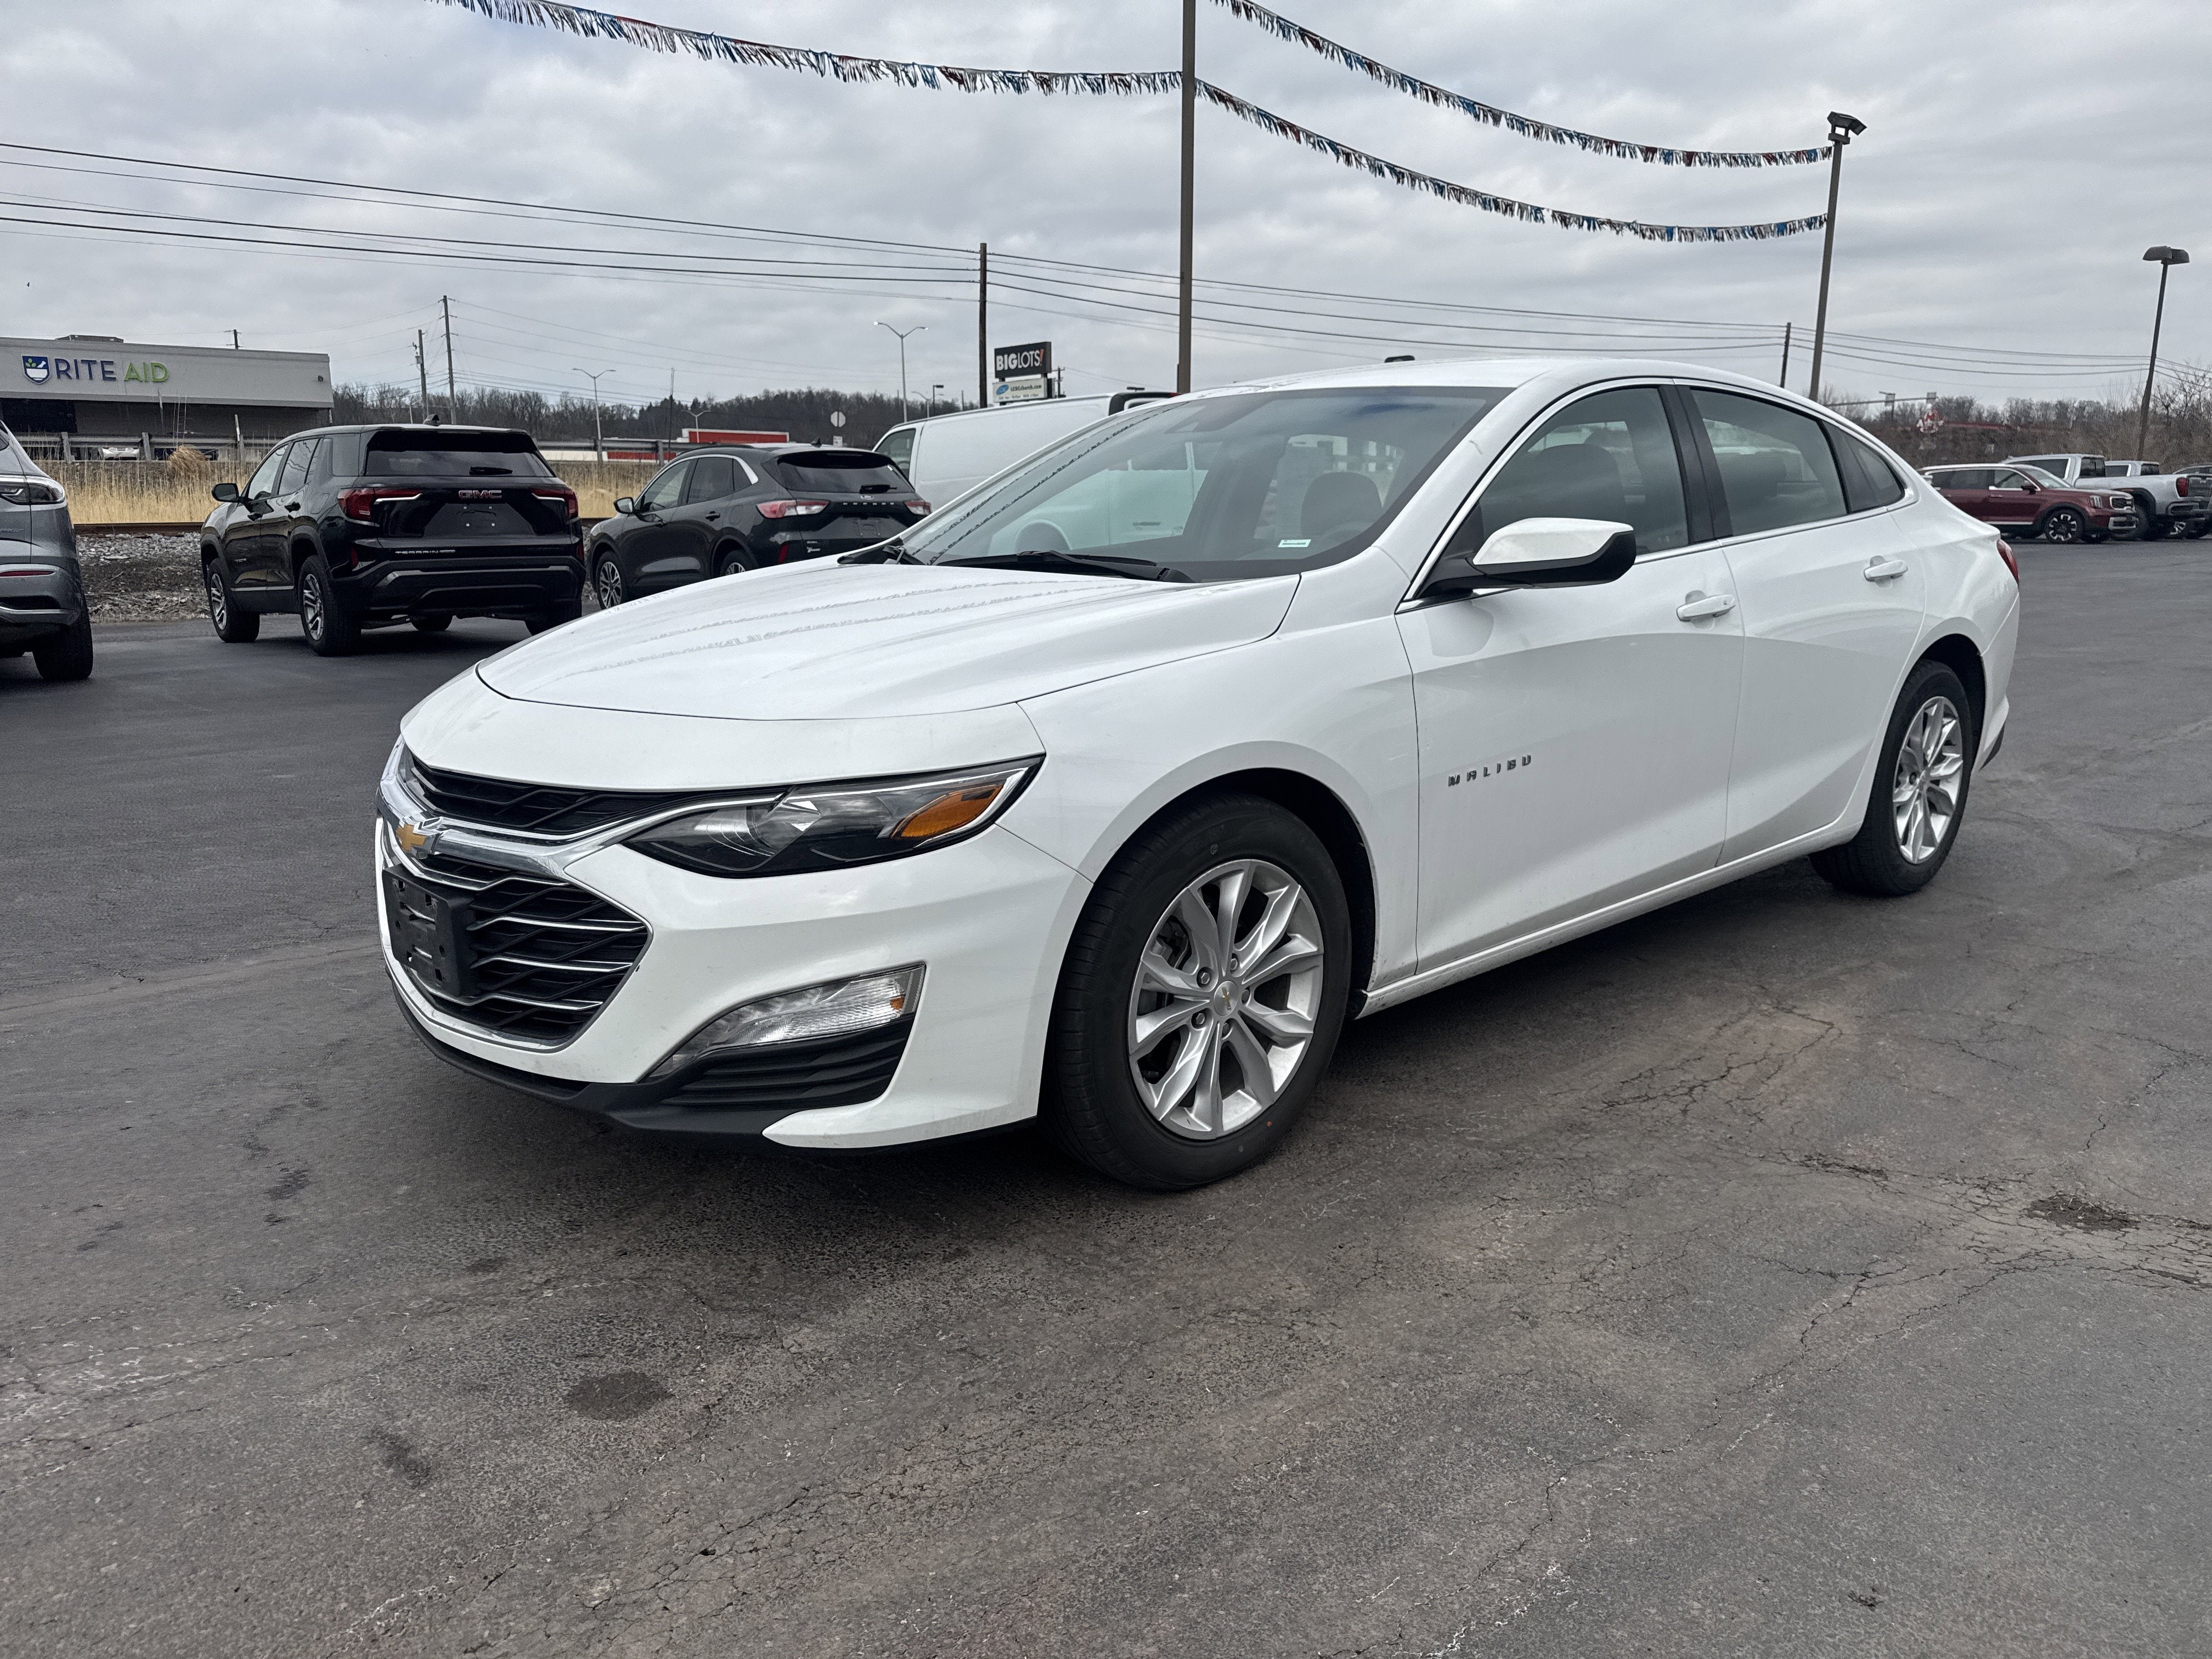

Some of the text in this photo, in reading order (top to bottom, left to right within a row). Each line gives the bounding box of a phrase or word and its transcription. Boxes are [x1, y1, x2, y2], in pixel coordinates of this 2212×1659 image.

[54, 358, 168, 383] RITE AID
[458, 489, 503, 499] GMC
[1448, 754, 1532, 787] MALIBU
